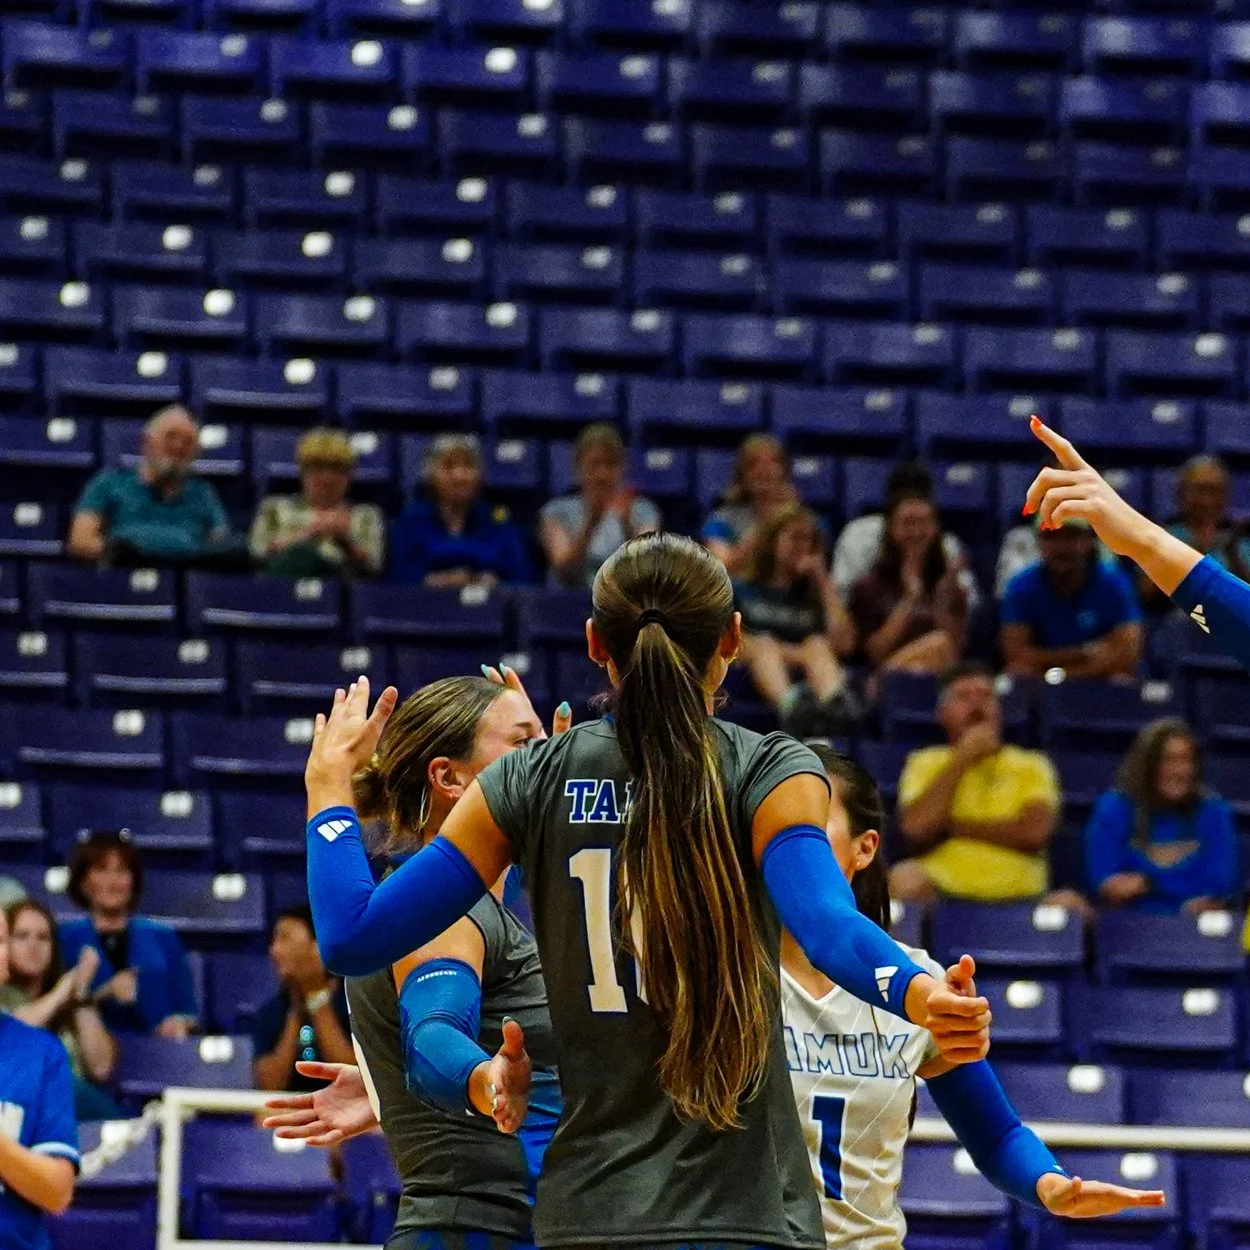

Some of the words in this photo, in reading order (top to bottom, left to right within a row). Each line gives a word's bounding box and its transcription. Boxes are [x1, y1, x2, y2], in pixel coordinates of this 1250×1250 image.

[564, 779, 633, 824] TA
[568, 848, 650, 1013] 1
[811, 1094, 846, 1201] 1
